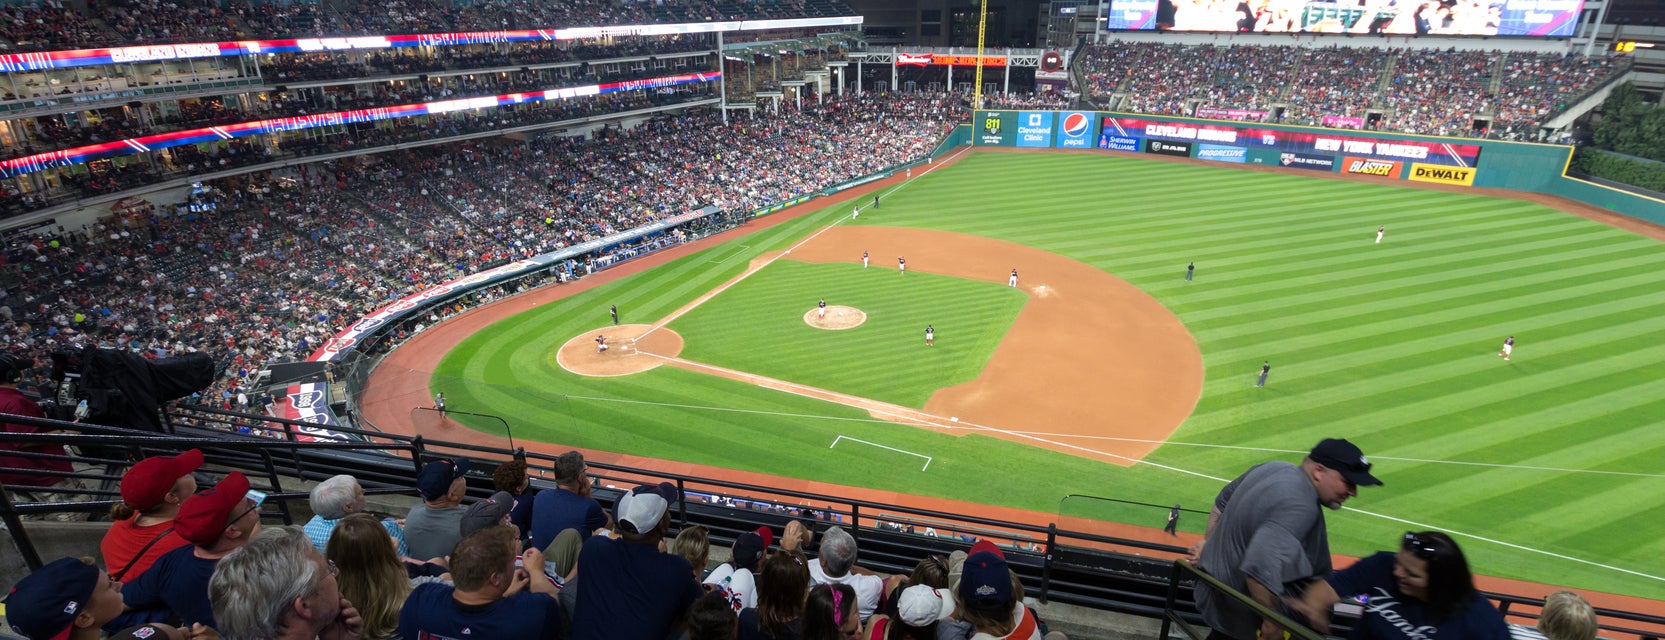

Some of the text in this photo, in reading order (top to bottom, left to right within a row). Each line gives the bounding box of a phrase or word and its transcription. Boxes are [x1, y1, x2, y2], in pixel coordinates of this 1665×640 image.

[985, 118, 1001, 129] 811
[1064, 138, 1084, 146] pepsi
[1145, 124, 1429, 159] CLEVELAND INDIANS VS NEW YORK YANKEES
[1162, 144, 1186, 152] RAM
[1198, 149, 1245, 157] PROGRESSIVE
[1305, 158, 1333, 166] NETWORK
[1348, 160, 1394, 176] BLASTER
